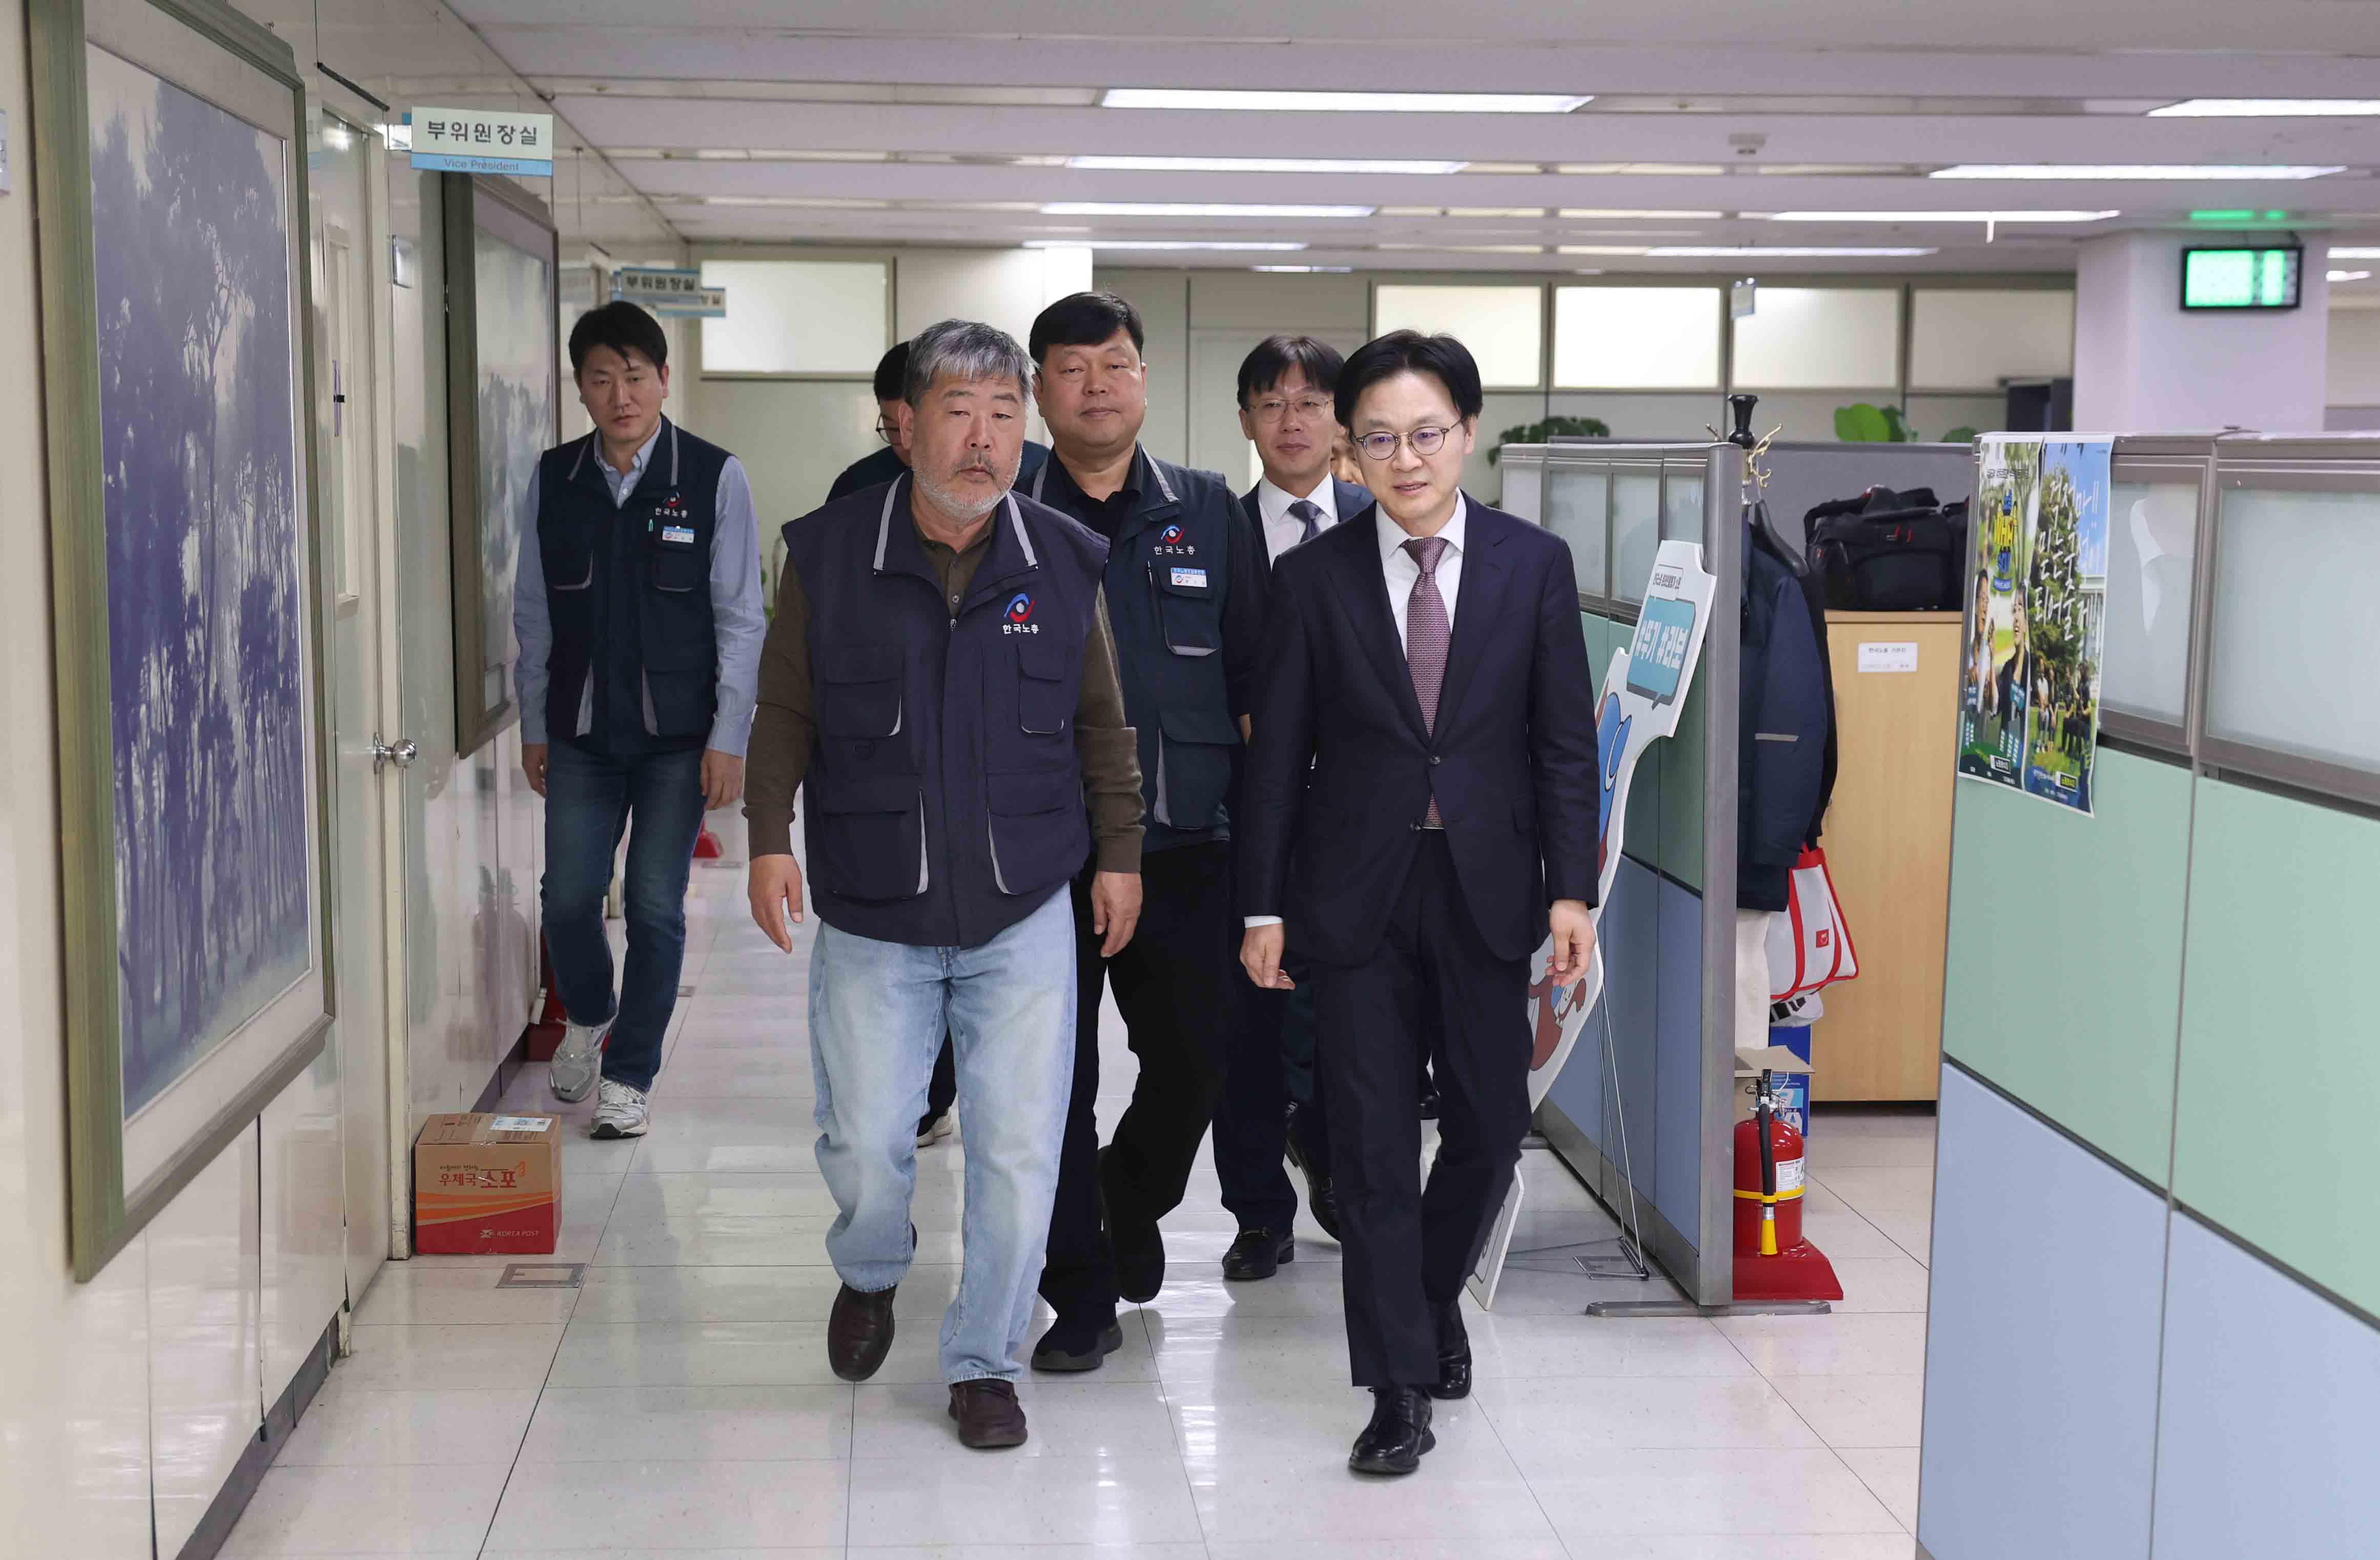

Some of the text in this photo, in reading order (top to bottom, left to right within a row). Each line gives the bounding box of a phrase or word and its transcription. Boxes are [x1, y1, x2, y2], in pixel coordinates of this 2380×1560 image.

[427, 121, 537, 145] 부위원장실
[443, 158, 519, 171] Vice President
[627, 275, 695, 291] 부위원장실
[1154, 545, 1196, 555] 한국노총
[1002, 624, 1039, 634] 한국노총
[496, 1230, 521, 1238] KOREA
